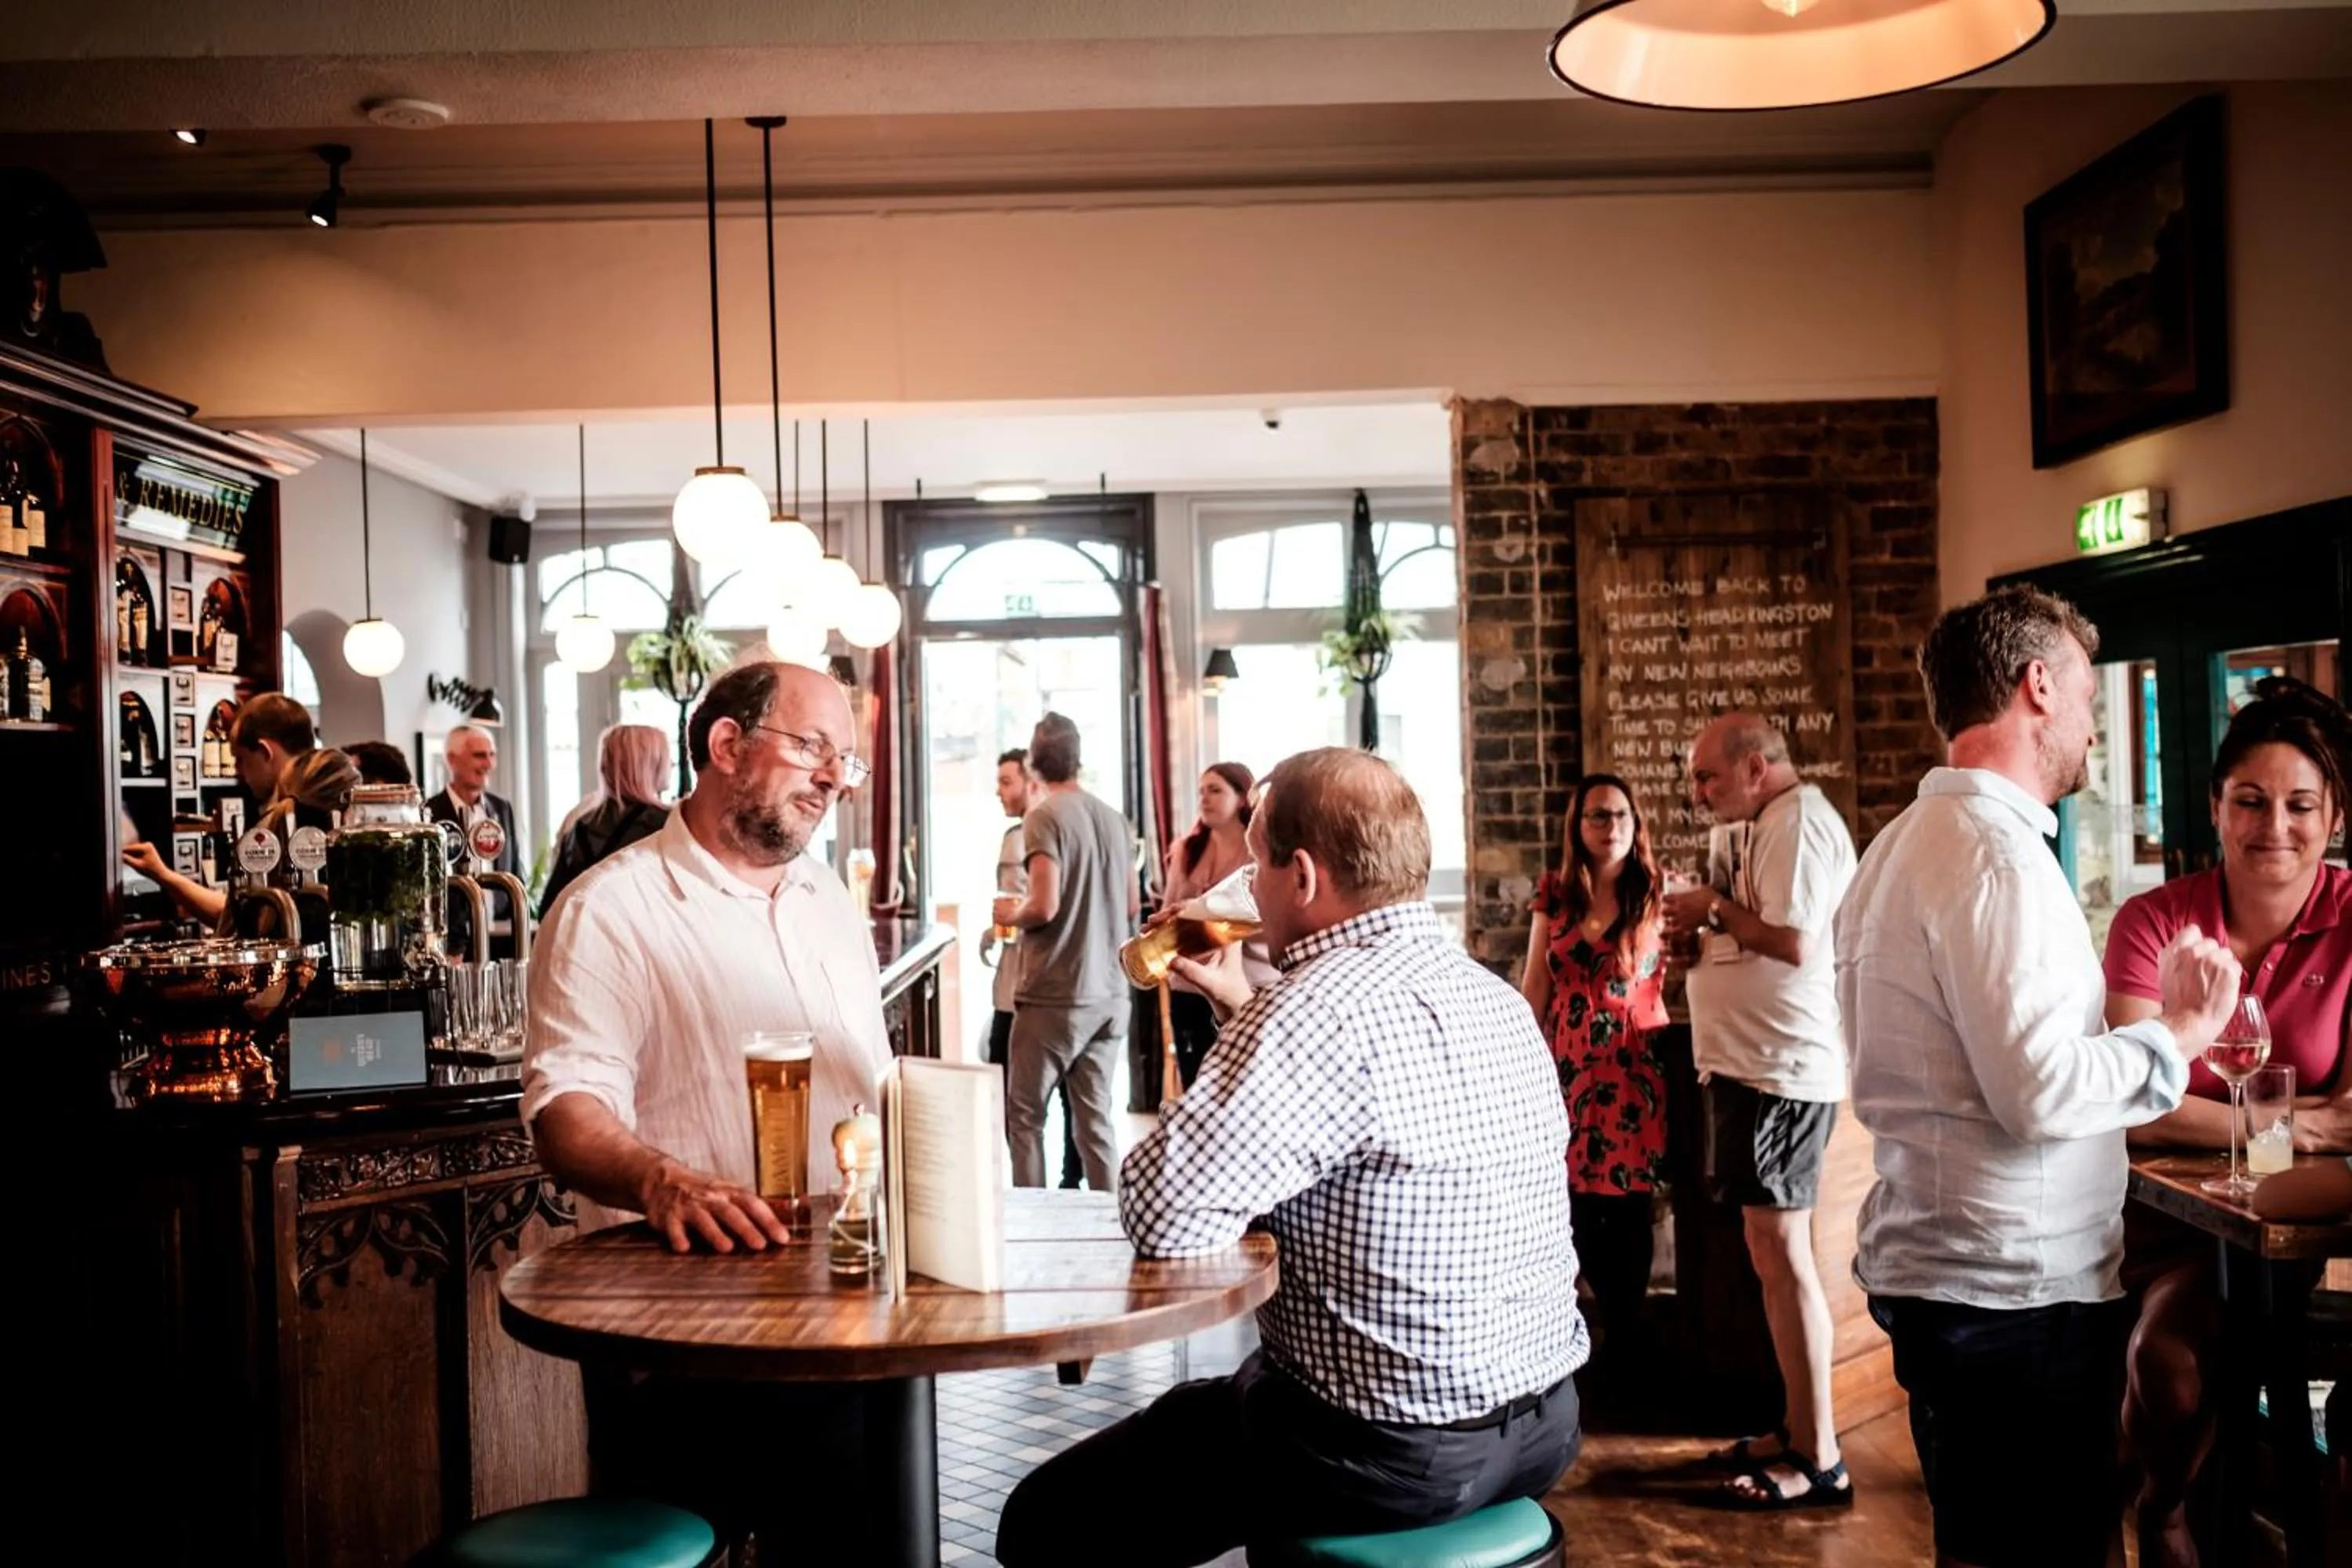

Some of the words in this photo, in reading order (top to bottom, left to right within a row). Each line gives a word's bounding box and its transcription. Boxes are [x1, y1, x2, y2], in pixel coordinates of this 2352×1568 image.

[139, 476, 243, 534] REMEDIES
[1602, 580, 1704, 603] WELCOME
[1716, 576, 1769, 595] BACK
[1780, 574, 1806, 593] TO
[1607, 610, 1691, 632] QUEENS
[1693, 607, 1745, 626] HEAD
[1748, 602, 1835, 624] KINGSTON
[1678, 633, 1721, 654] WAIT
[1726, 633, 1748, 651] TO
[1754, 628, 1811, 649] MEET
[1608, 665, 1633, 683] MY
[1644, 662, 1688, 682] NEW
[1693, 655, 1802, 681] NEIGHBOURS
[1608, 690, 1680, 711] PLEASE
[1686, 690, 1730, 710] GIVE
[1733, 688, 1758, 705] US
[1761, 685, 1814, 706] SOME
[1610, 713, 1650, 735] TIME
[1653, 718, 1677, 735] TO
[1795, 711, 1835, 734] ANY
[1613, 739, 1653, 759] NEW
[1, 961, 53, 992] INES
